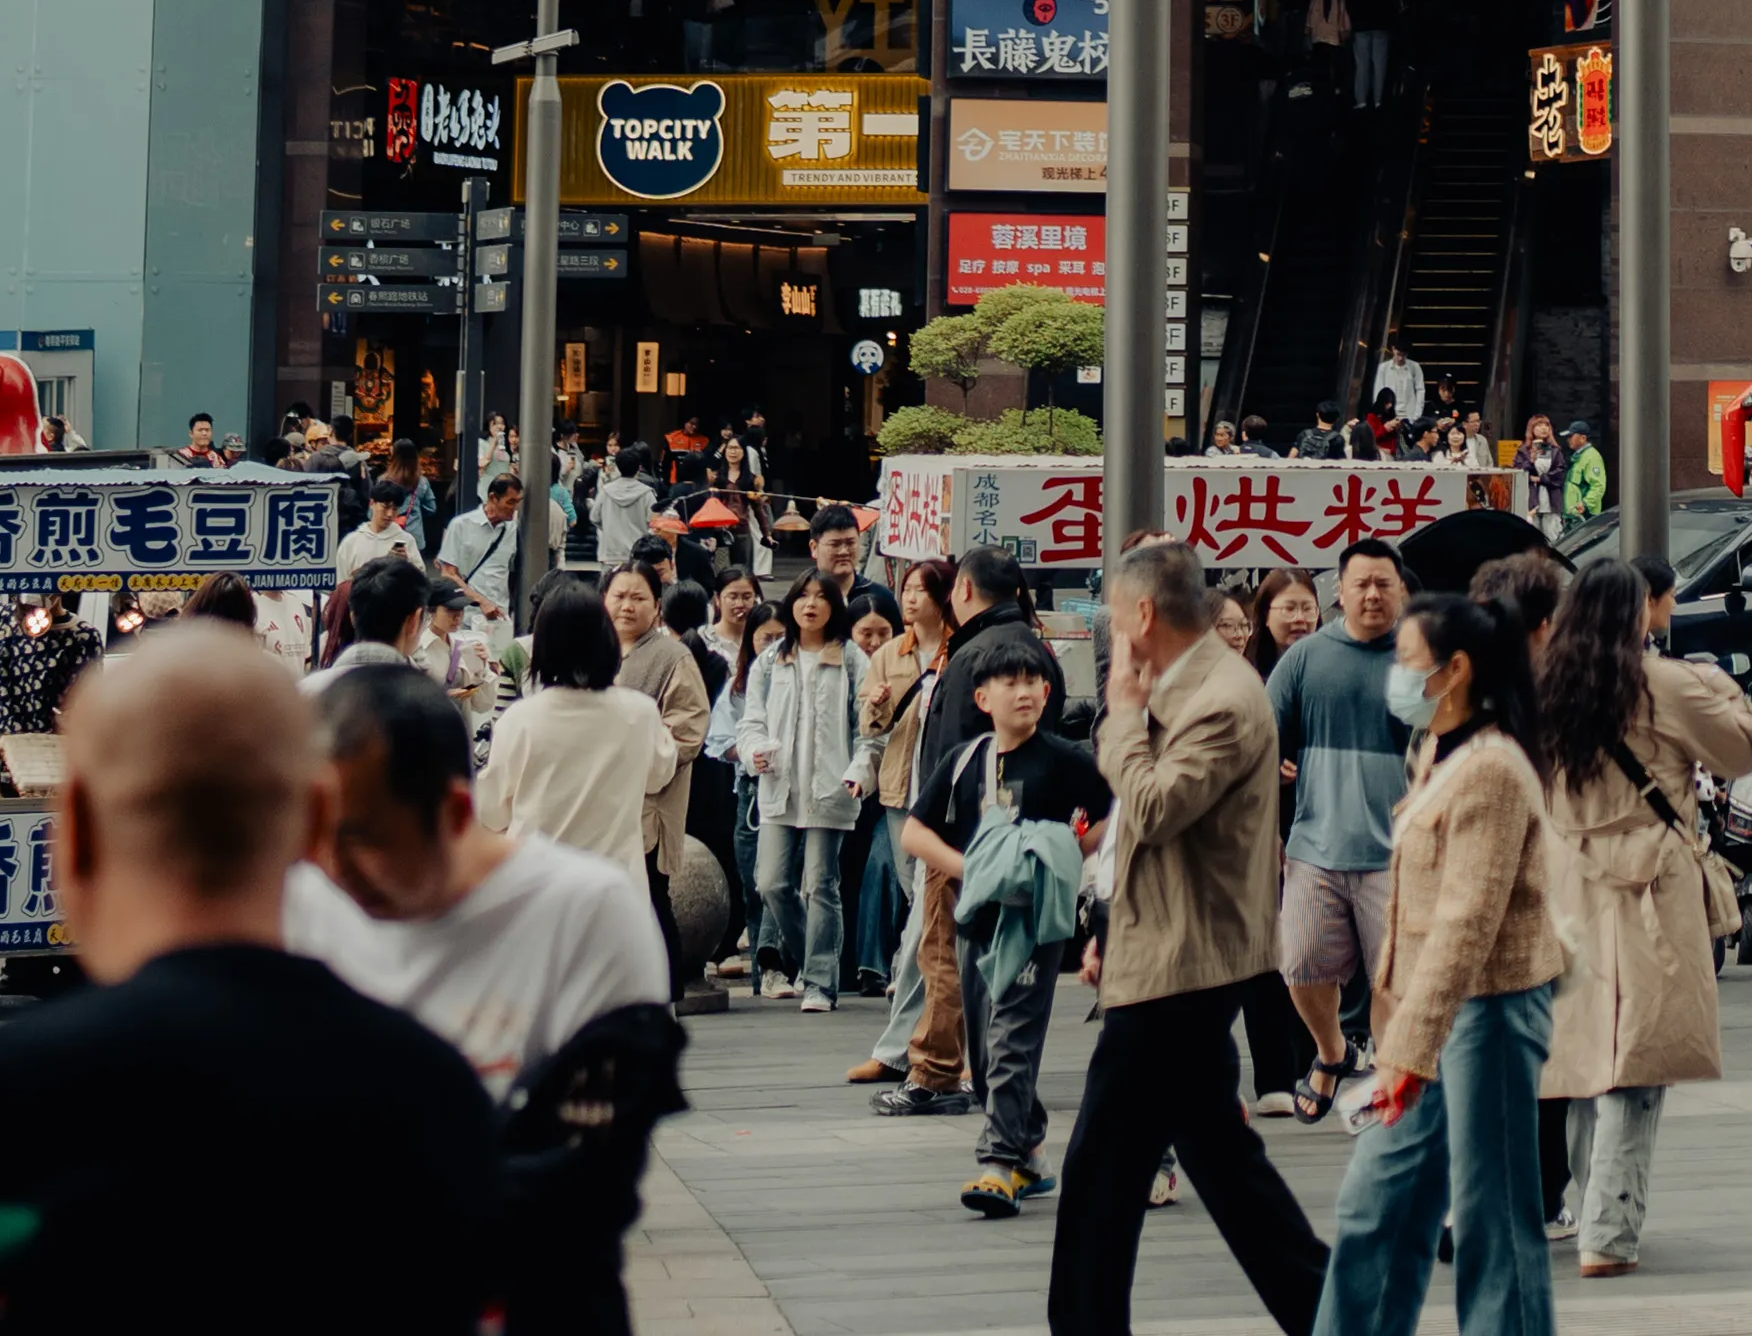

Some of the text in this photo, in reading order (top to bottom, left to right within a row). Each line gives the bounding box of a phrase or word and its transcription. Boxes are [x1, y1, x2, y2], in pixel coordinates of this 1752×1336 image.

[951, 26, 1109, 75] 長藤鬼校
[610, 117, 712, 140] TOPCITY
[766, 89, 919, 160] 第一
[625, 140, 694, 162] WALK
[791, 172, 912, 183] TRENDY AND VIBRANT
[1042, 166, 1097, 181] 观光梯上
[991, 224, 1088, 251] 蓉溪里境
[958, 259, 986, 275] 足疗
[991, 259, 1020, 275] 按摩
[1025, 261, 1051, 276] spa
[1058, 260, 1086, 275] 采耳
[367, 289, 429, 303] 春熙路地铁站
[251, 572, 336, 588] JIAN MAO DOU FU
